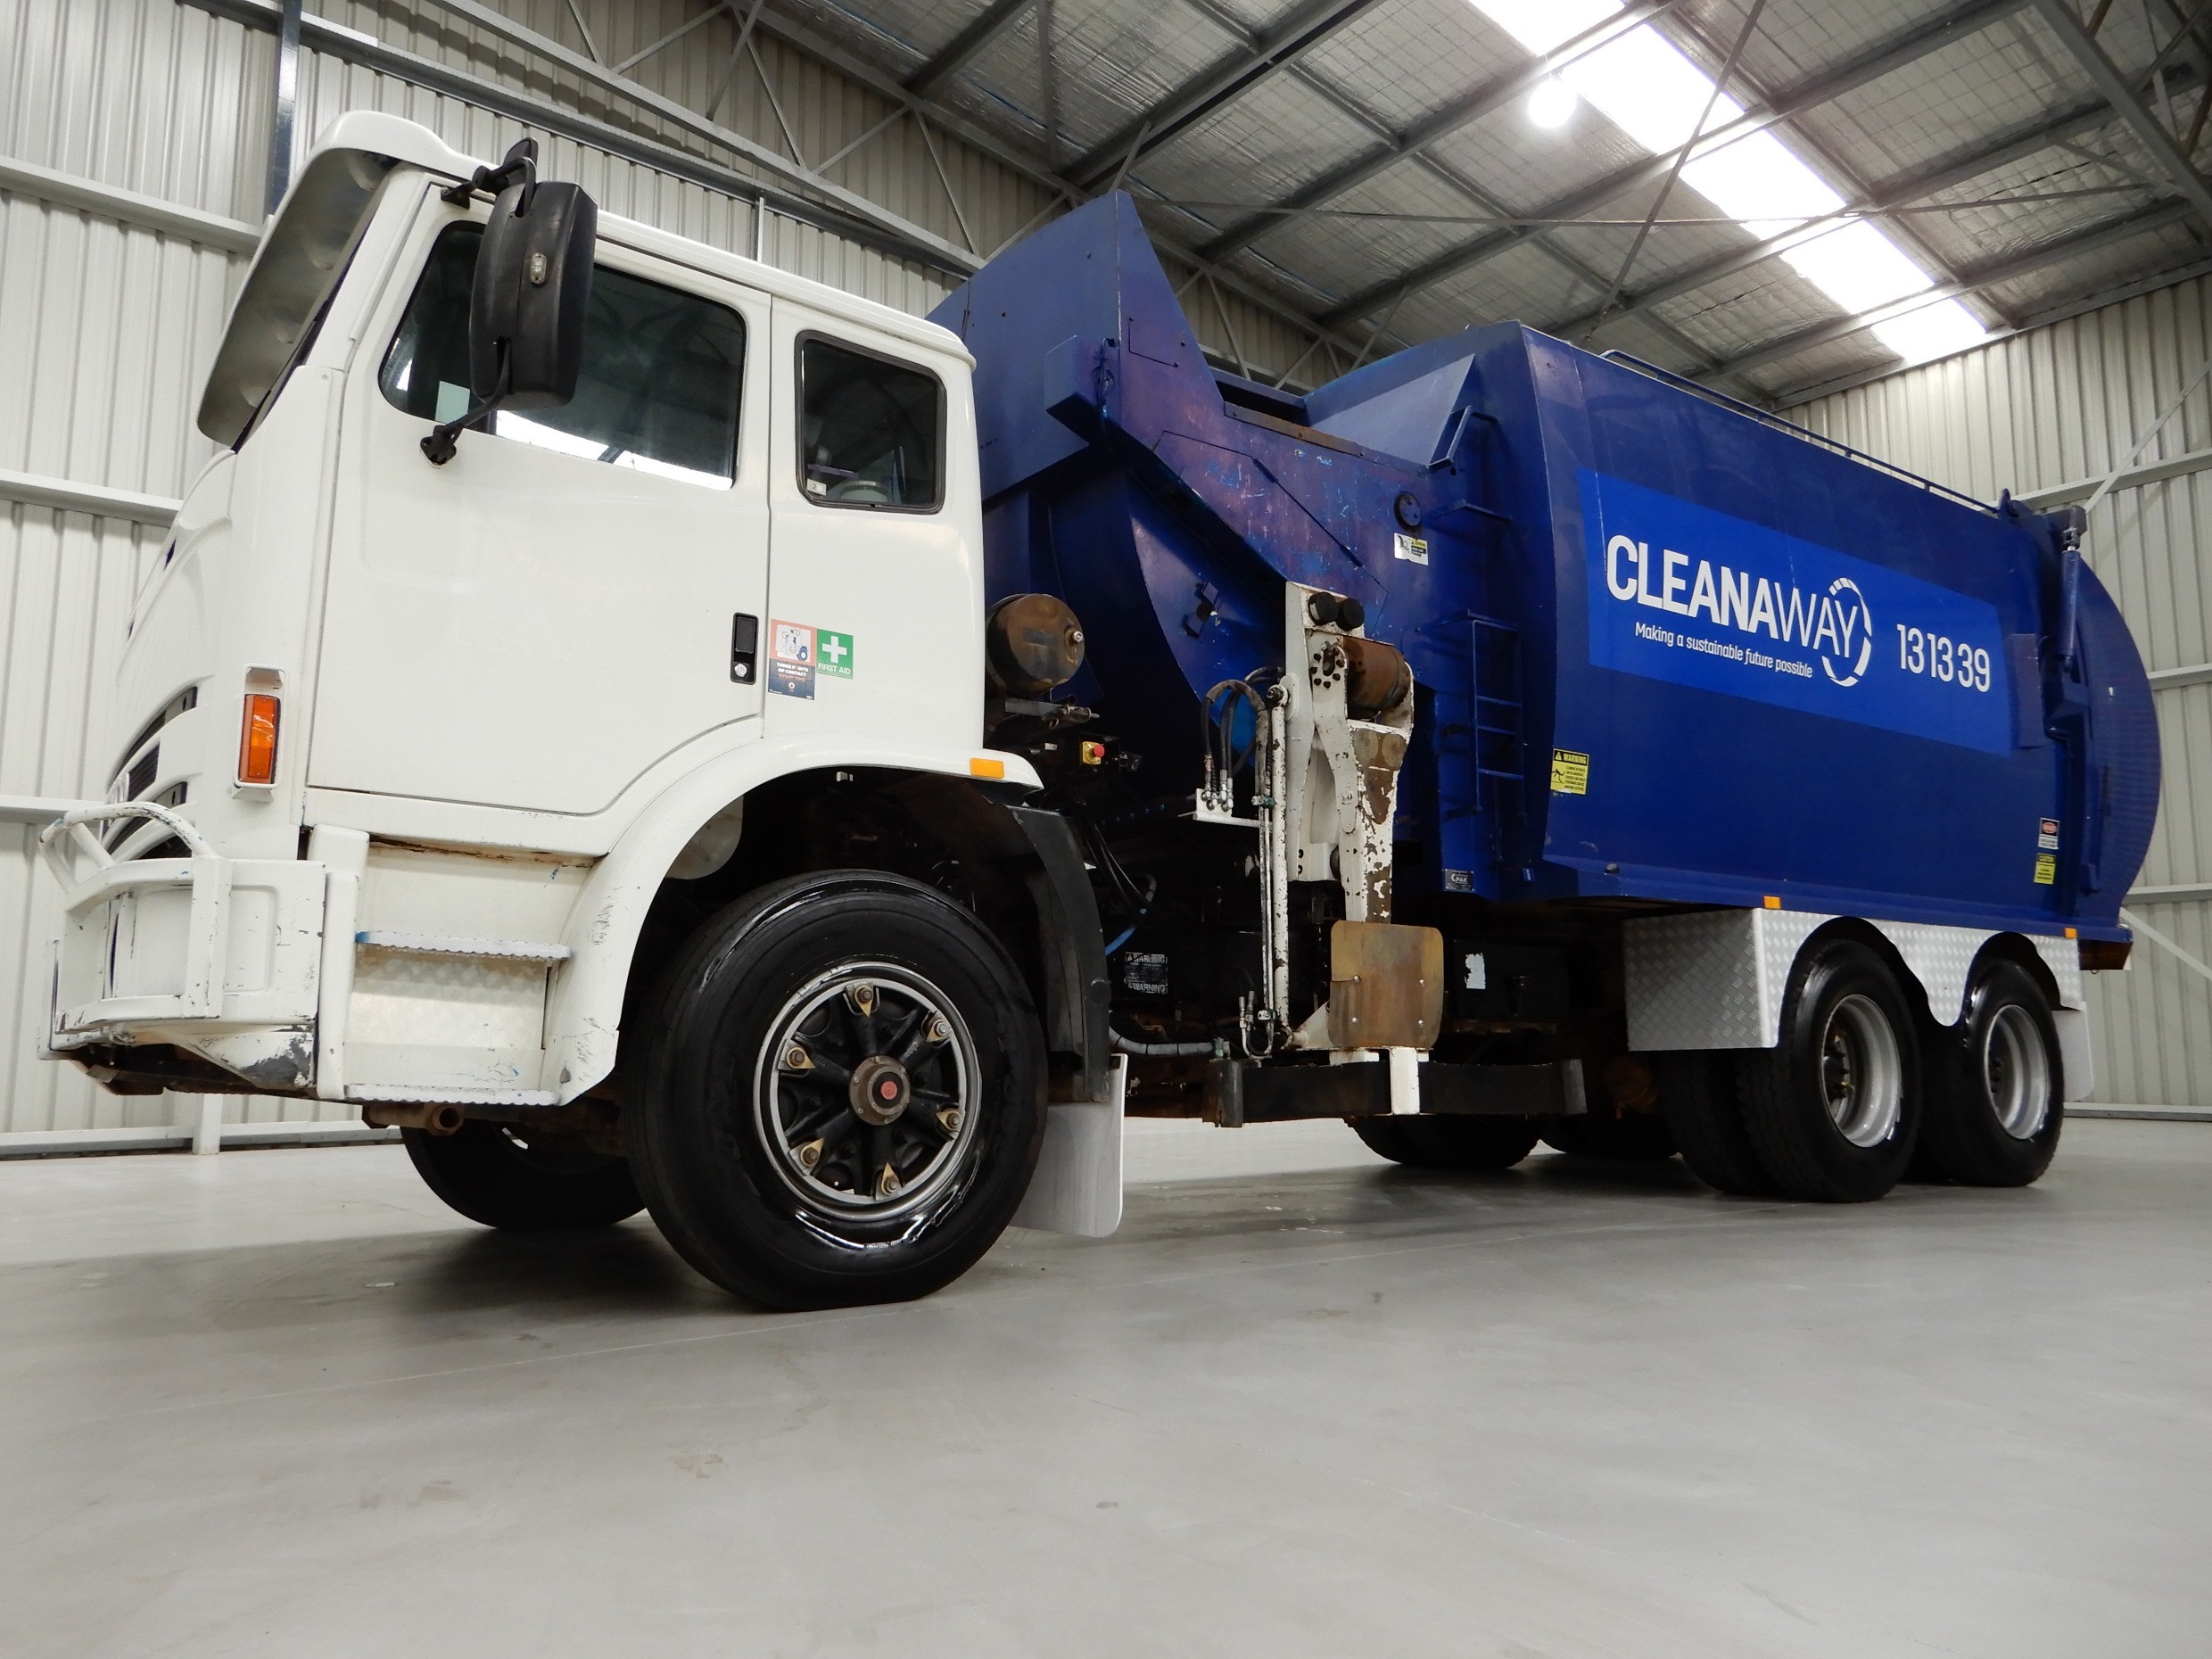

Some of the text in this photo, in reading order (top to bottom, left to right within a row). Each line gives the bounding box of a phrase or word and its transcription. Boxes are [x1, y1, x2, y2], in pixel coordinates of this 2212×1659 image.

[1607, 535, 1858, 658] CLEANAWAY
[1635, 622, 1813, 679] Making a sustainable future possible
[776, 662, 809, 673] THREE POINTS
[785, 669, 807, 677] CONTACT
[817, 663, 851, 675] FIRST AID
[1563, 753, 1587, 765] WARNING
